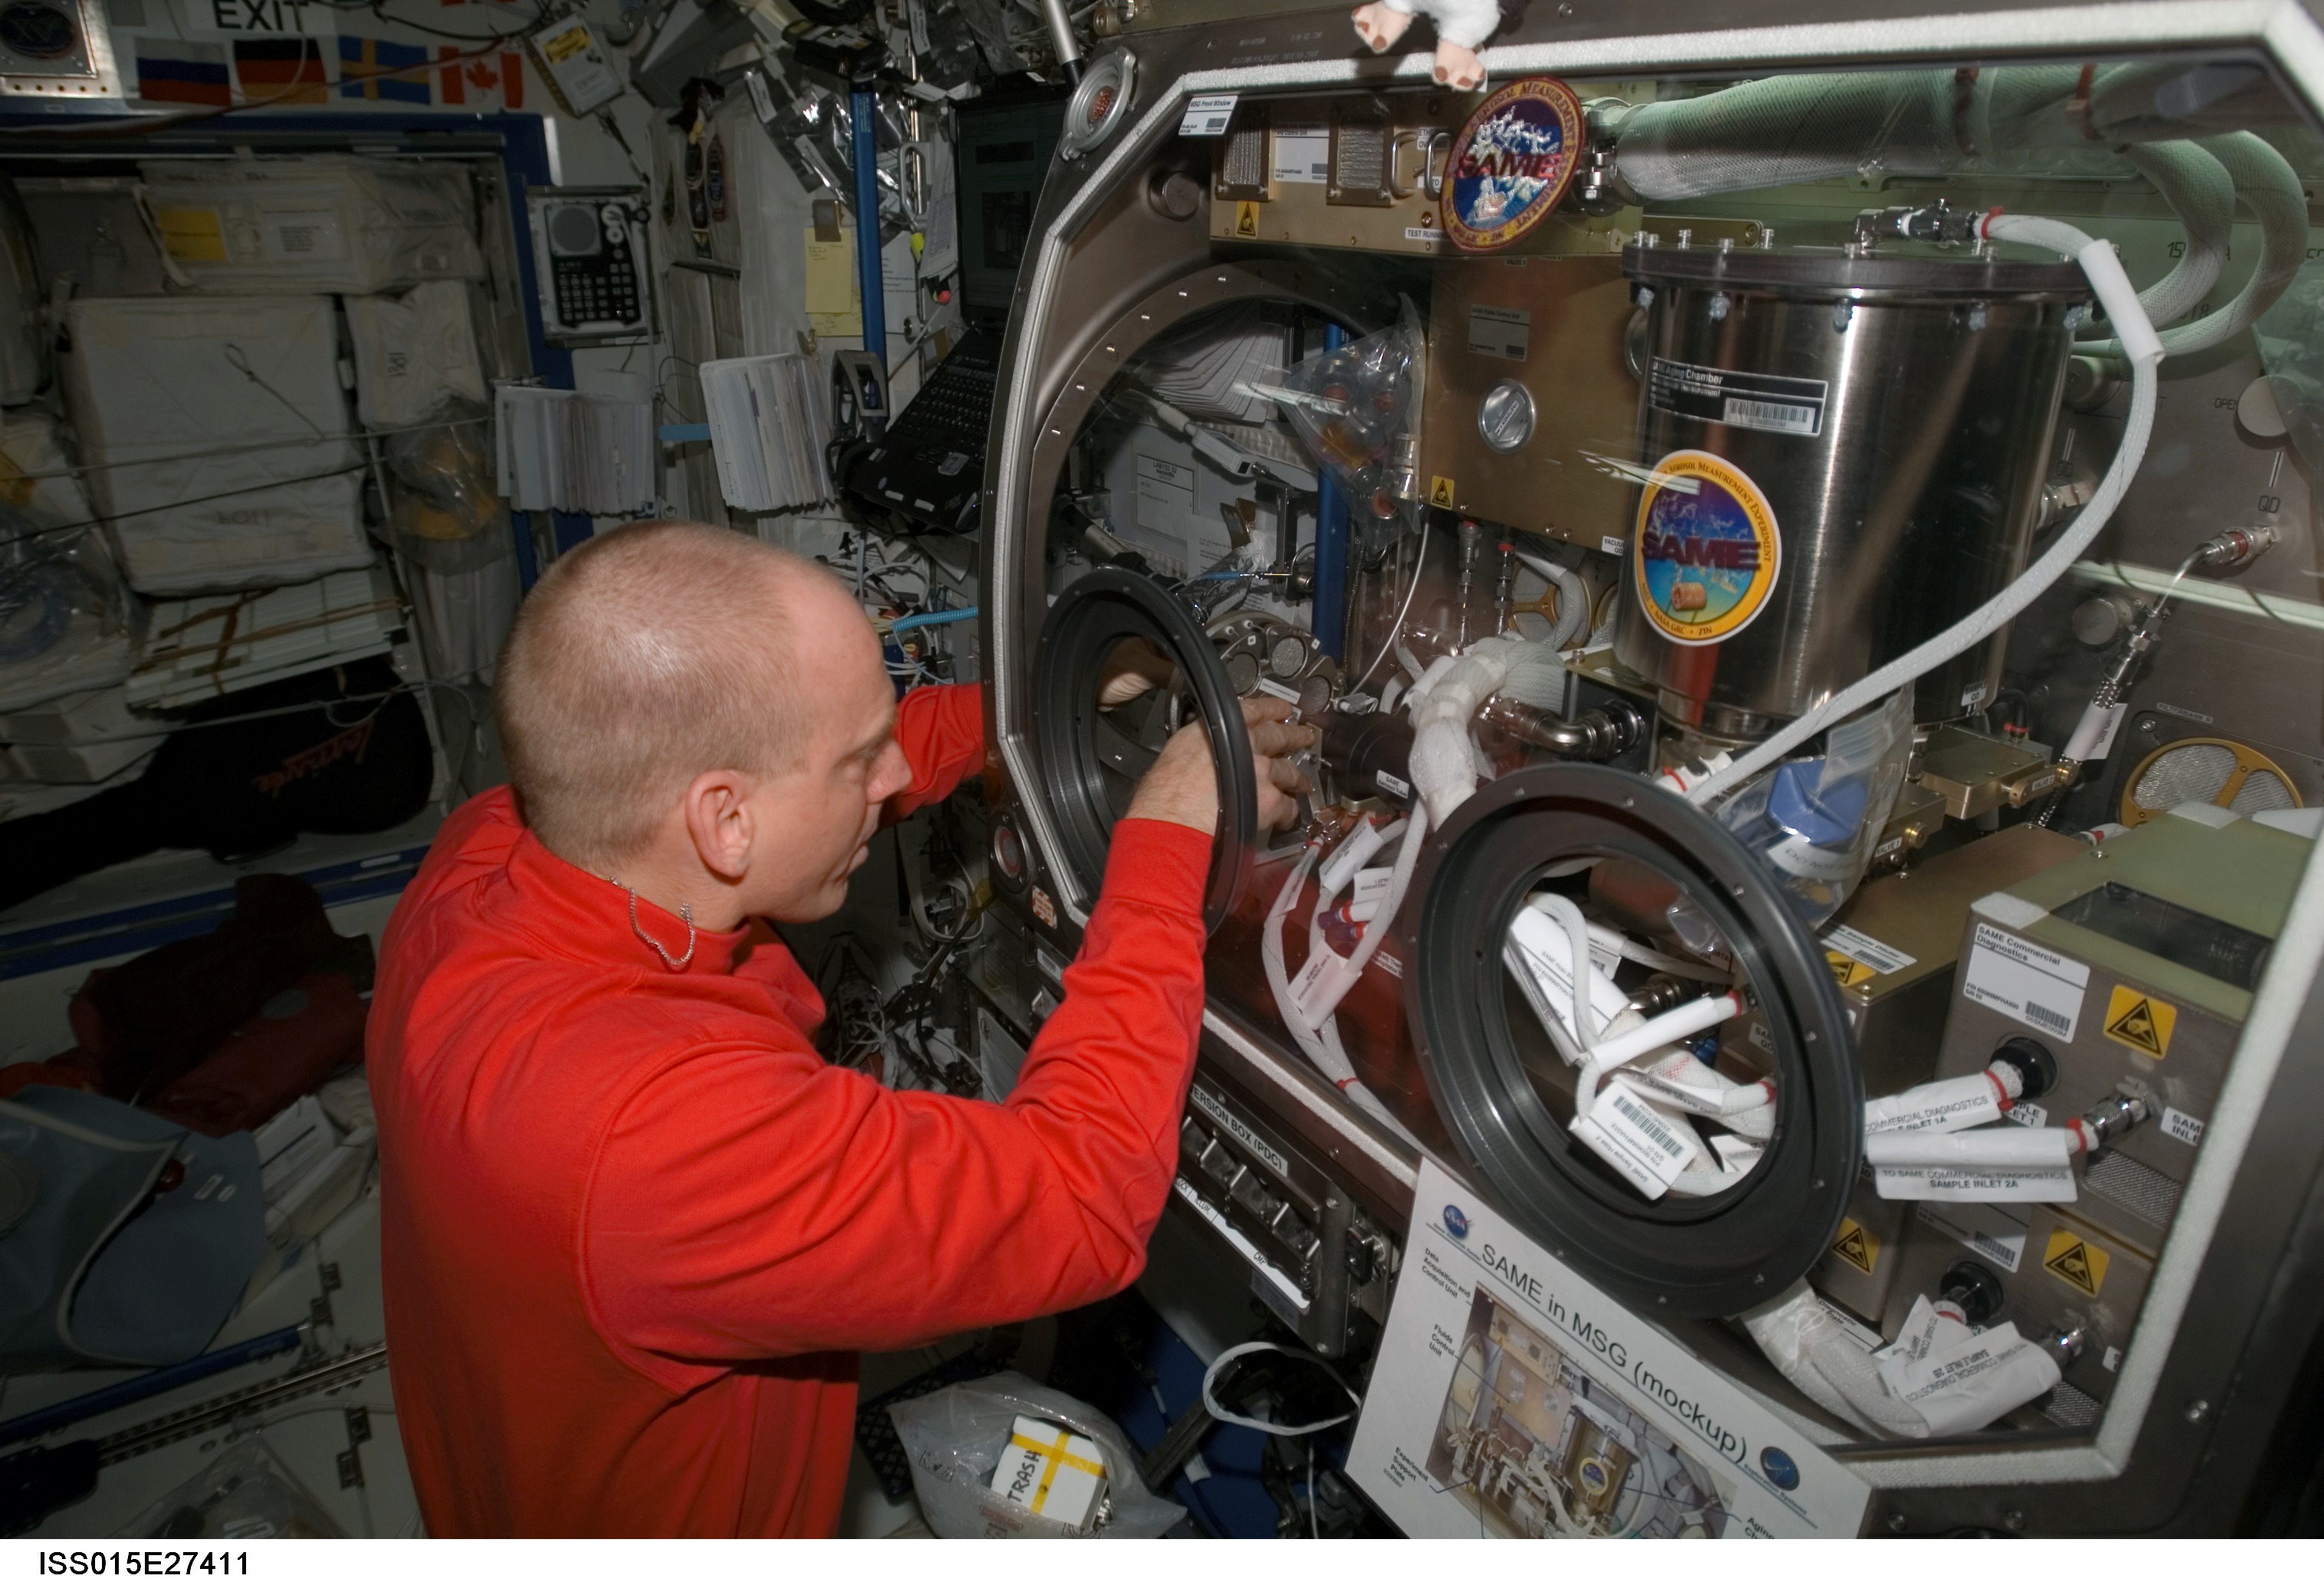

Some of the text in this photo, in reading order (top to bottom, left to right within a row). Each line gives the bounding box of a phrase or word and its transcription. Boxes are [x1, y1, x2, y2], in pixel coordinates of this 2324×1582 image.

[215, 0, 309, 31] EXIT
[1457, 152, 1564, 179] SAME
[1407, 228, 1422, 238] TEST
[1666, 366, 1685, 379] Aging
[1686, 369, 1723, 385] Chamber
[1668, 461, 1772, 563] AEROSOL MEASUREMENT EXPERIMENT
[2257, 495, 2281, 514] QD
[1642, 530, 1762, 572] SAME
[1699, 627, 1713, 636] ZIN
[1965, 681, 1988, 694] SAMPLE
[2158, 703, 2203, 722] FILTERBANK
[1378, 780, 1397, 792] Aerosol
[1385, 776, 1400, 788] SAME
[1877, 842, 1895, 855] VALVE
[1976, 934, 2028, 962] Diagnostics
[1978, 925, 2061, 966] SAME Commercial
[1541, 950, 1558, 966] SAME
[1925, 1095, 1989, 1118] DIAGNOSTICS
[1907, 1116, 1948, 1131] INLET 1A
[1231, 1118, 1252, 1145] BOX
[1254, 1139, 1282, 1170] (PDC)
[1600, 1138, 1614, 1152] Hose
[1613, 1150, 1631, 1170] Sample
[1632, 1167, 1649, 1183] SAME
[1883, 1170, 2069, 1180] TO SAME COMMERCIAL DIAGNOSTICS
[1929, 1180, 2019, 1189] SAMPLE INLET 2A
[1444, 1211, 1466, 1231] NASA
[1425, 1248, 1439, 1262] Data
[1466, 1246, 1482, 1262] Center
[1422, 1265, 1458, 1299] Control Unit
[1423, 1257, 1471, 1298] Acquisition and
[1434, 1323, 1454, 1344] Fluids
[1429, 1342, 1443, 1358] Unit
[1431, 1333, 1456, 1357] Control
[1482, 1243, 1747, 1464] SAME in MSG (mockup)
[1945, 1359, 1967, 1374] INLET
[1967, 1348, 1991, 1367] SAMPLE
[1956, 1357, 1998, 1382] COMMERCIAL
[1905, 1374, 1957, 1403] DIAGNOSTICS
[1390, 1464, 1406, 1482] Plate
[1392, 1455, 1416, 1482] Support
[1395, 1446, 1429, 1482] Experiment
[1006, 1449, 1043, 1503] TRASH
[1744, 1463, 1807, 1515] Exploration Systems
[1747, 1517, 1775, 1539] Aging
